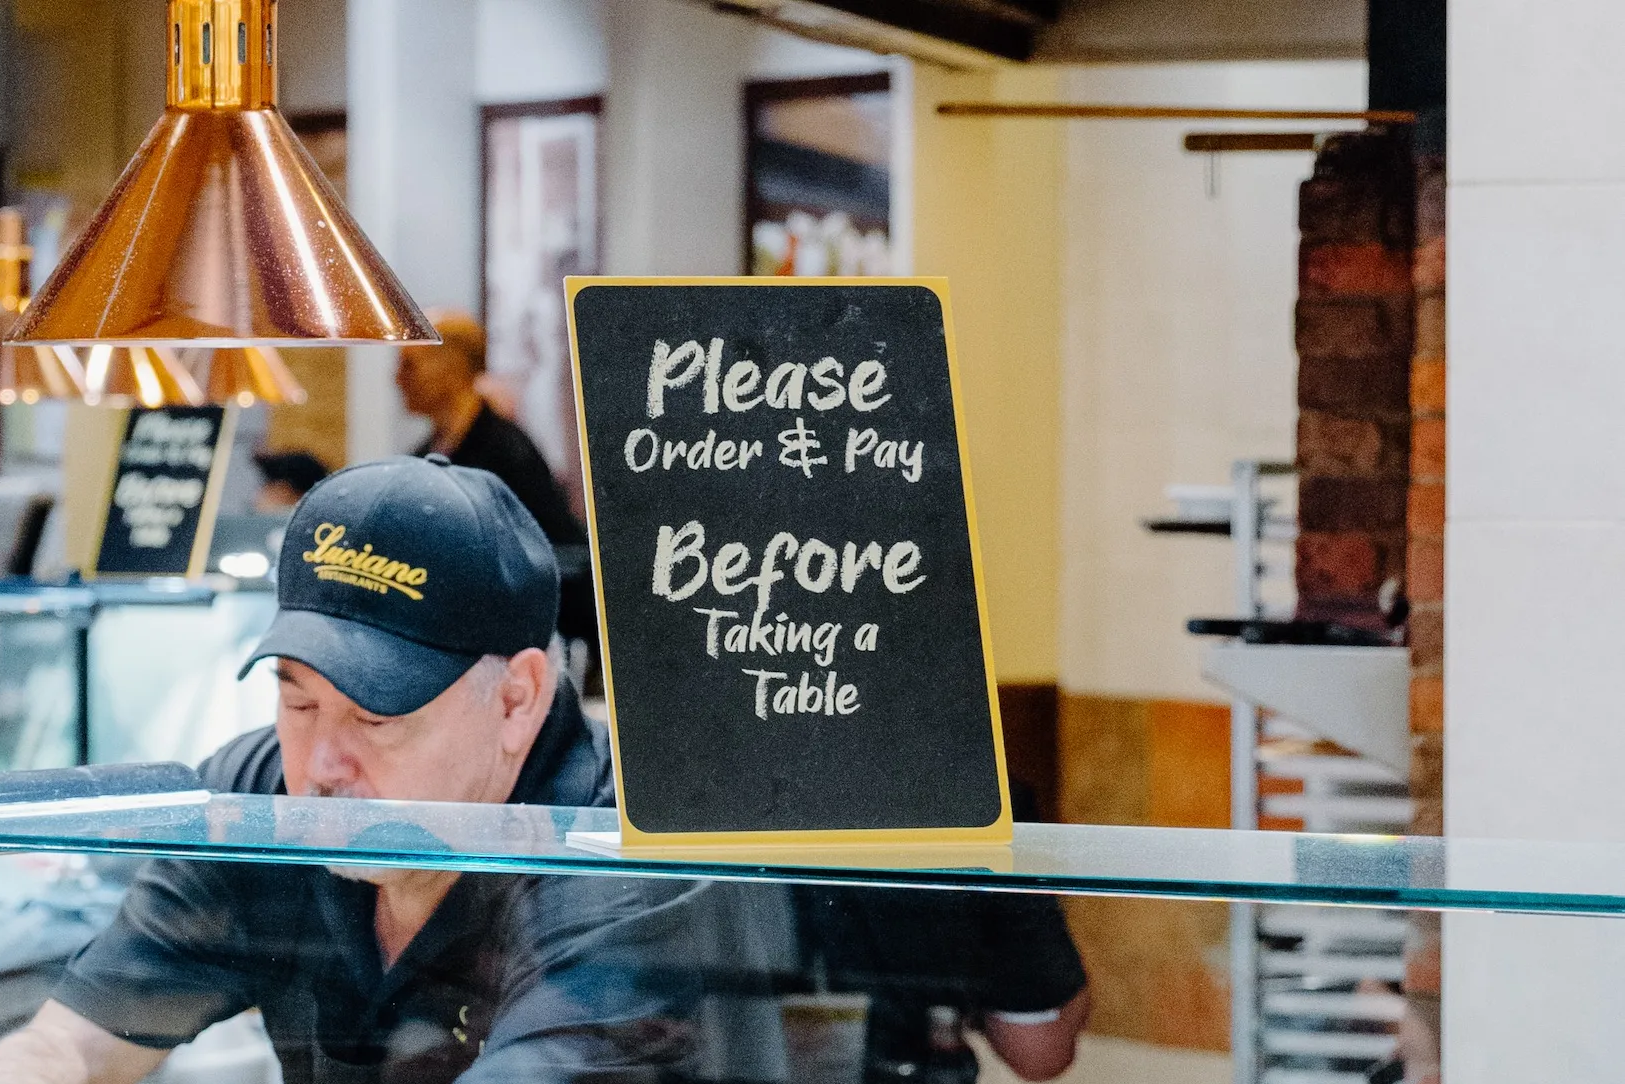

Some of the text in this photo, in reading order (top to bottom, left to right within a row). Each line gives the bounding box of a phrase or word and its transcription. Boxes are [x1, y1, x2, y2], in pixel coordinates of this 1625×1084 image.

[645, 337, 893, 419] Please
[624, 417, 925, 483] Order & Pay
[302, 522, 428, 586] Luciano
[651, 520, 928, 616] Before
[692, 607, 879, 667] Taking a
[741, 667, 861, 721] Table
